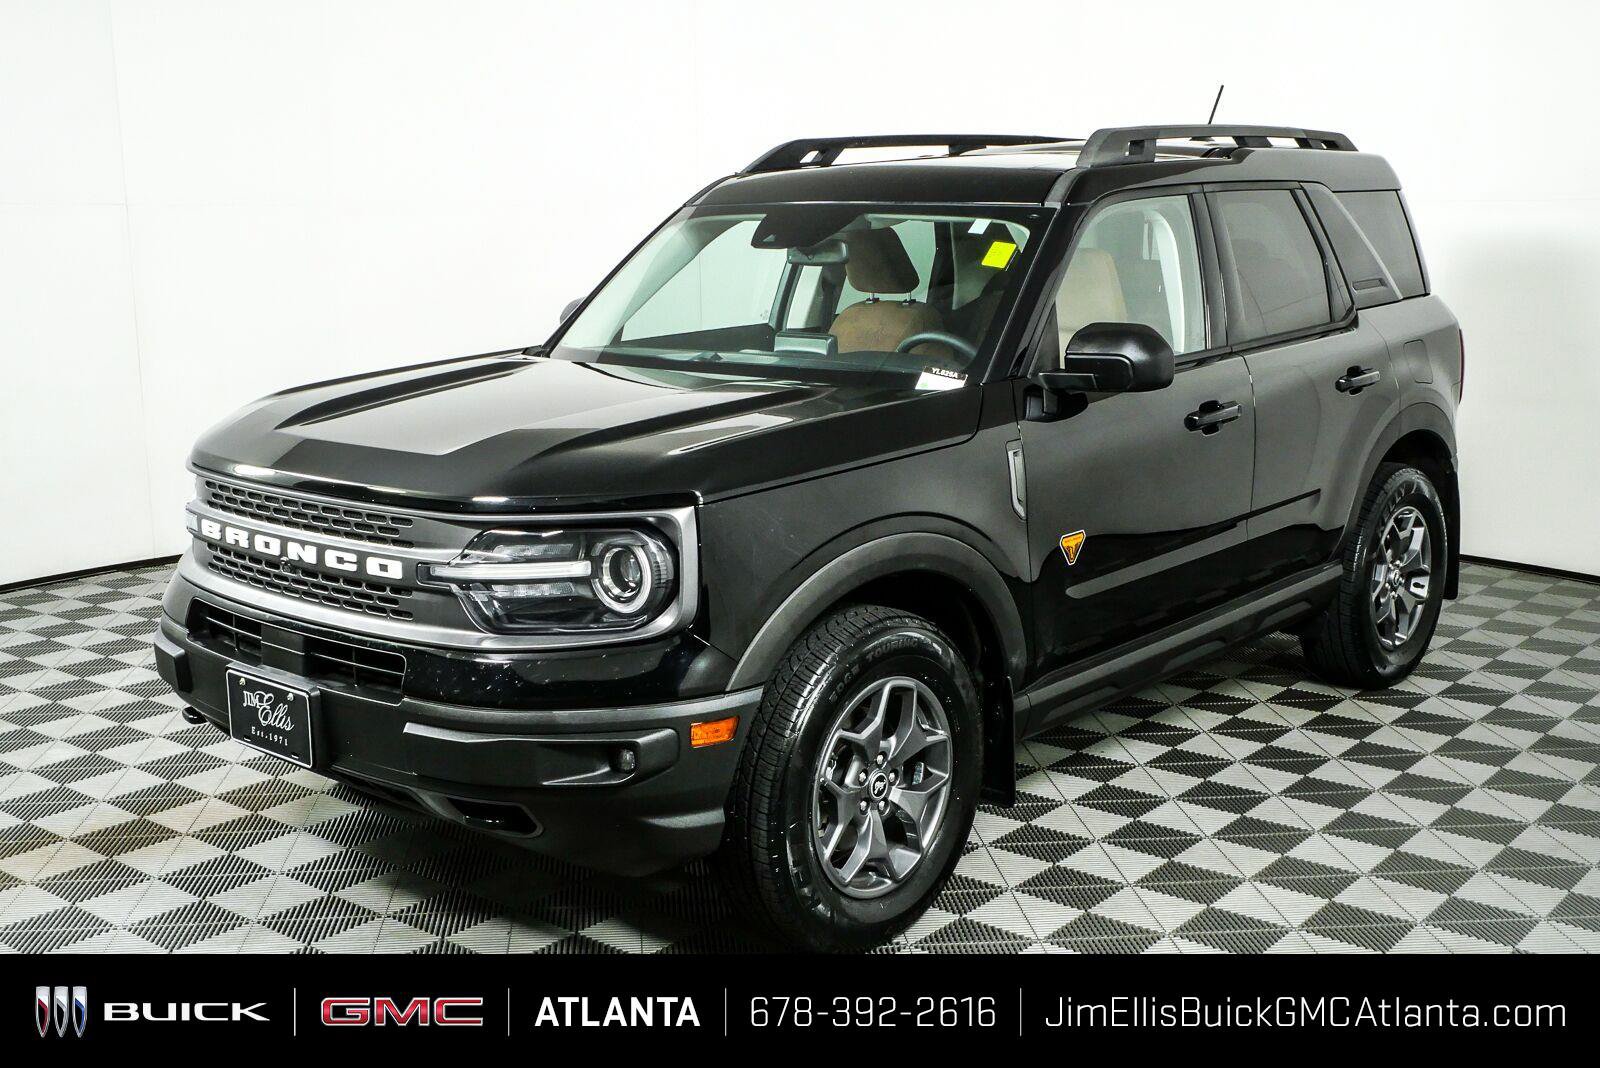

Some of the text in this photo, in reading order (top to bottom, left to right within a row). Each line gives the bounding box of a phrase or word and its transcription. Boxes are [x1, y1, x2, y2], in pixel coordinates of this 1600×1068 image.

[201, 518, 403, 579] BRONCO
[866, 637, 918, 662] TOURING
[243, 690, 294, 731] JIM Ellis
